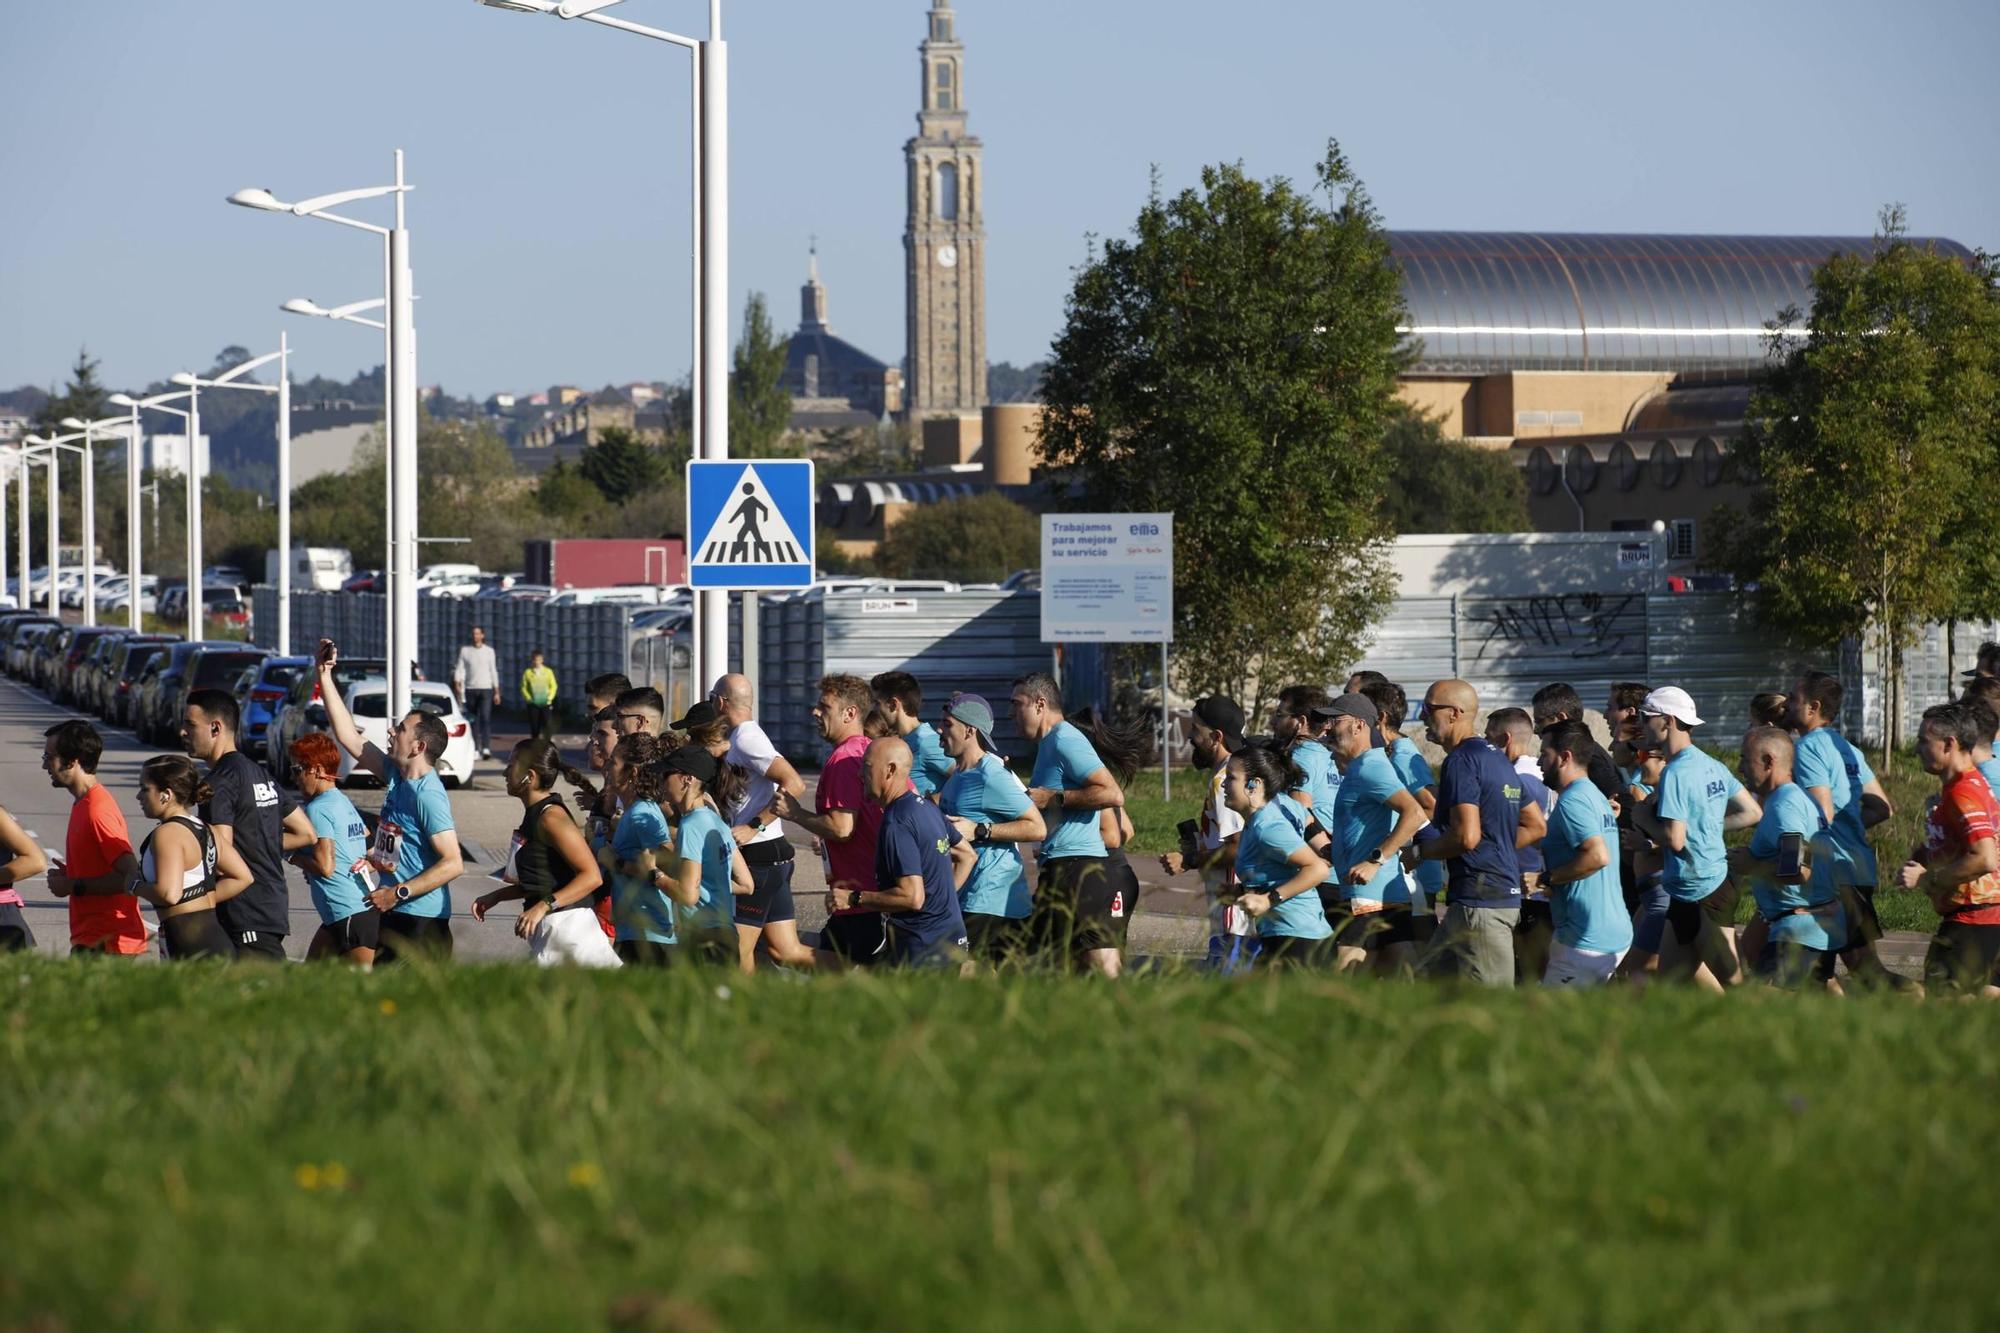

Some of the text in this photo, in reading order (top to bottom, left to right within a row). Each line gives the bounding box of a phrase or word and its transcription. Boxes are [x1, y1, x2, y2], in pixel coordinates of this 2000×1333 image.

[1052, 523, 1112, 534] Trabajamos
[1130, 523, 1159, 536] ema
[1052, 536, 1117, 546] para mejorar
[1052, 548, 1108, 557] su servicio
